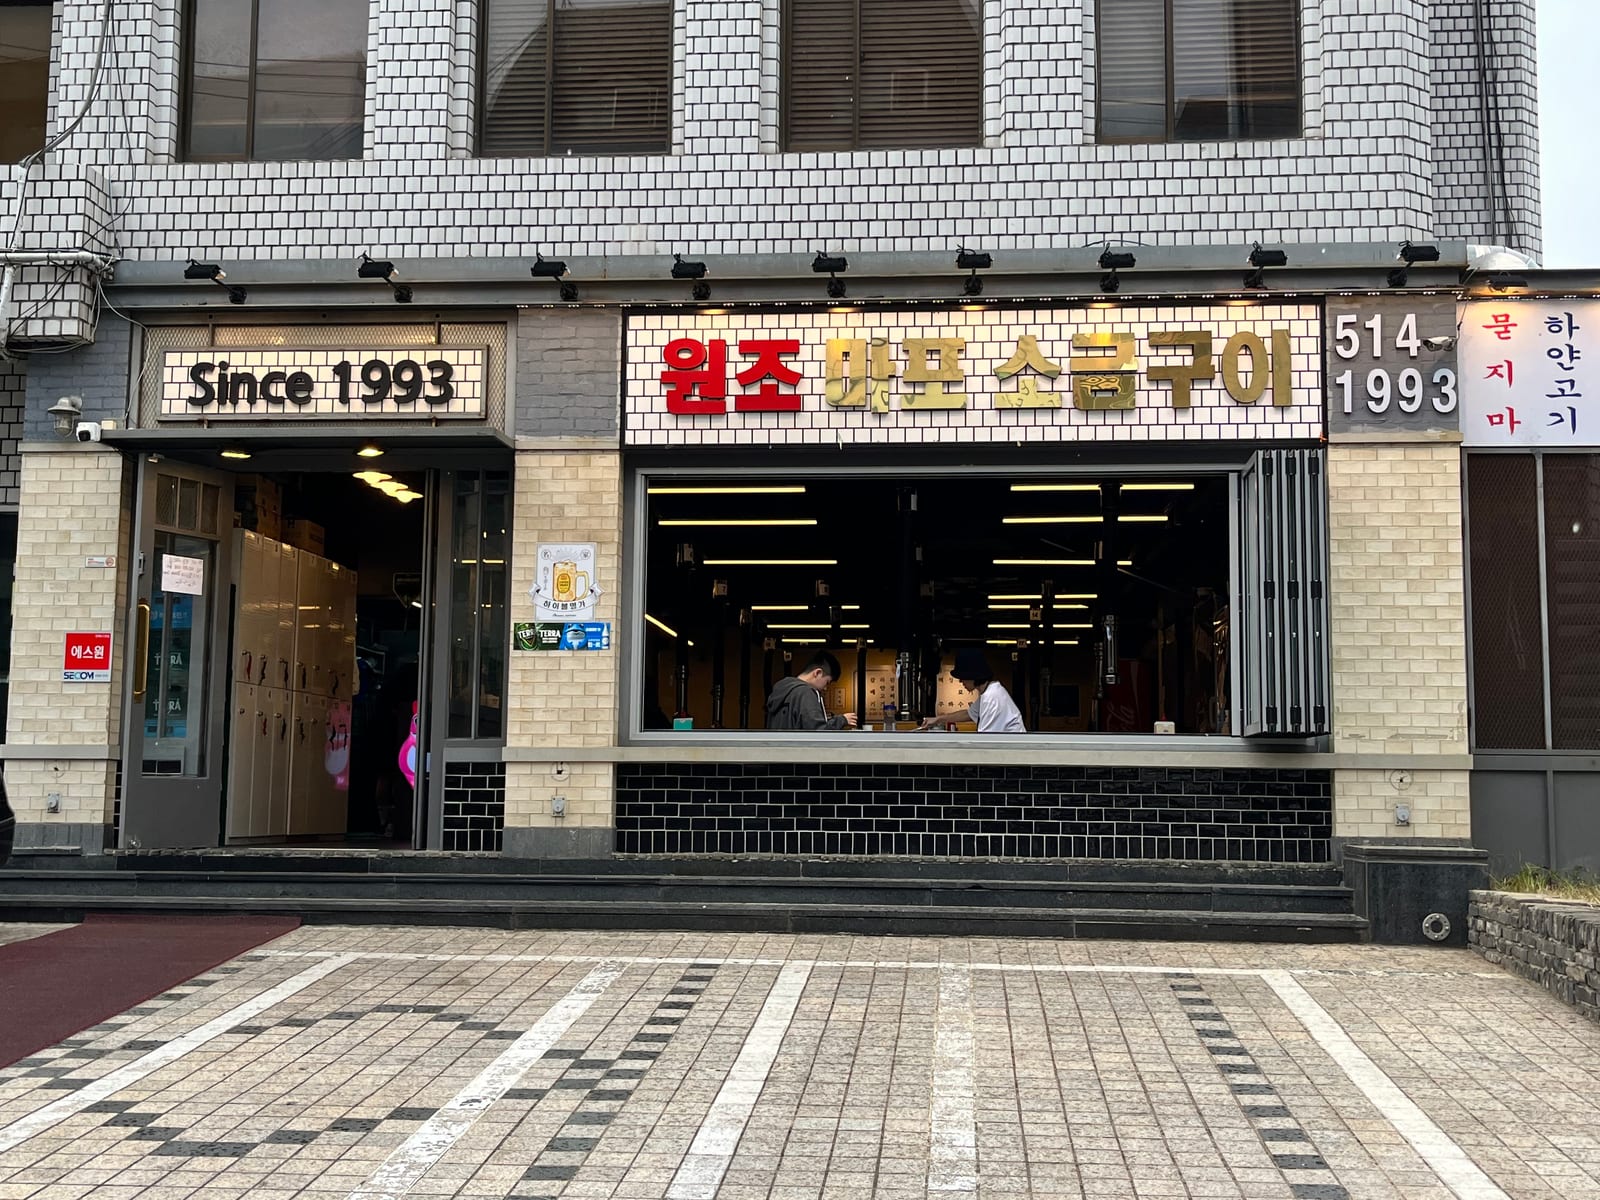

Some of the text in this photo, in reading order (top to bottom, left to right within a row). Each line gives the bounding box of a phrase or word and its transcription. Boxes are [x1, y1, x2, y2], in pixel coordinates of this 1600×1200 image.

[1335, 313, 1421, 359] 514
[187, 359, 454, 406] Since 1993
[661, 329, 1292, 415] 원조 마포 소금구이
[1335, 367, 1457, 414] 1993
[1482, 313, 1522, 436] 묻지마
[1543, 312, 1582, 436] 하얀고기
[71, 645, 104, 659] 에스원
[538, 630, 562, 638] TERRA
[64, 671, 94, 680] SECOM
